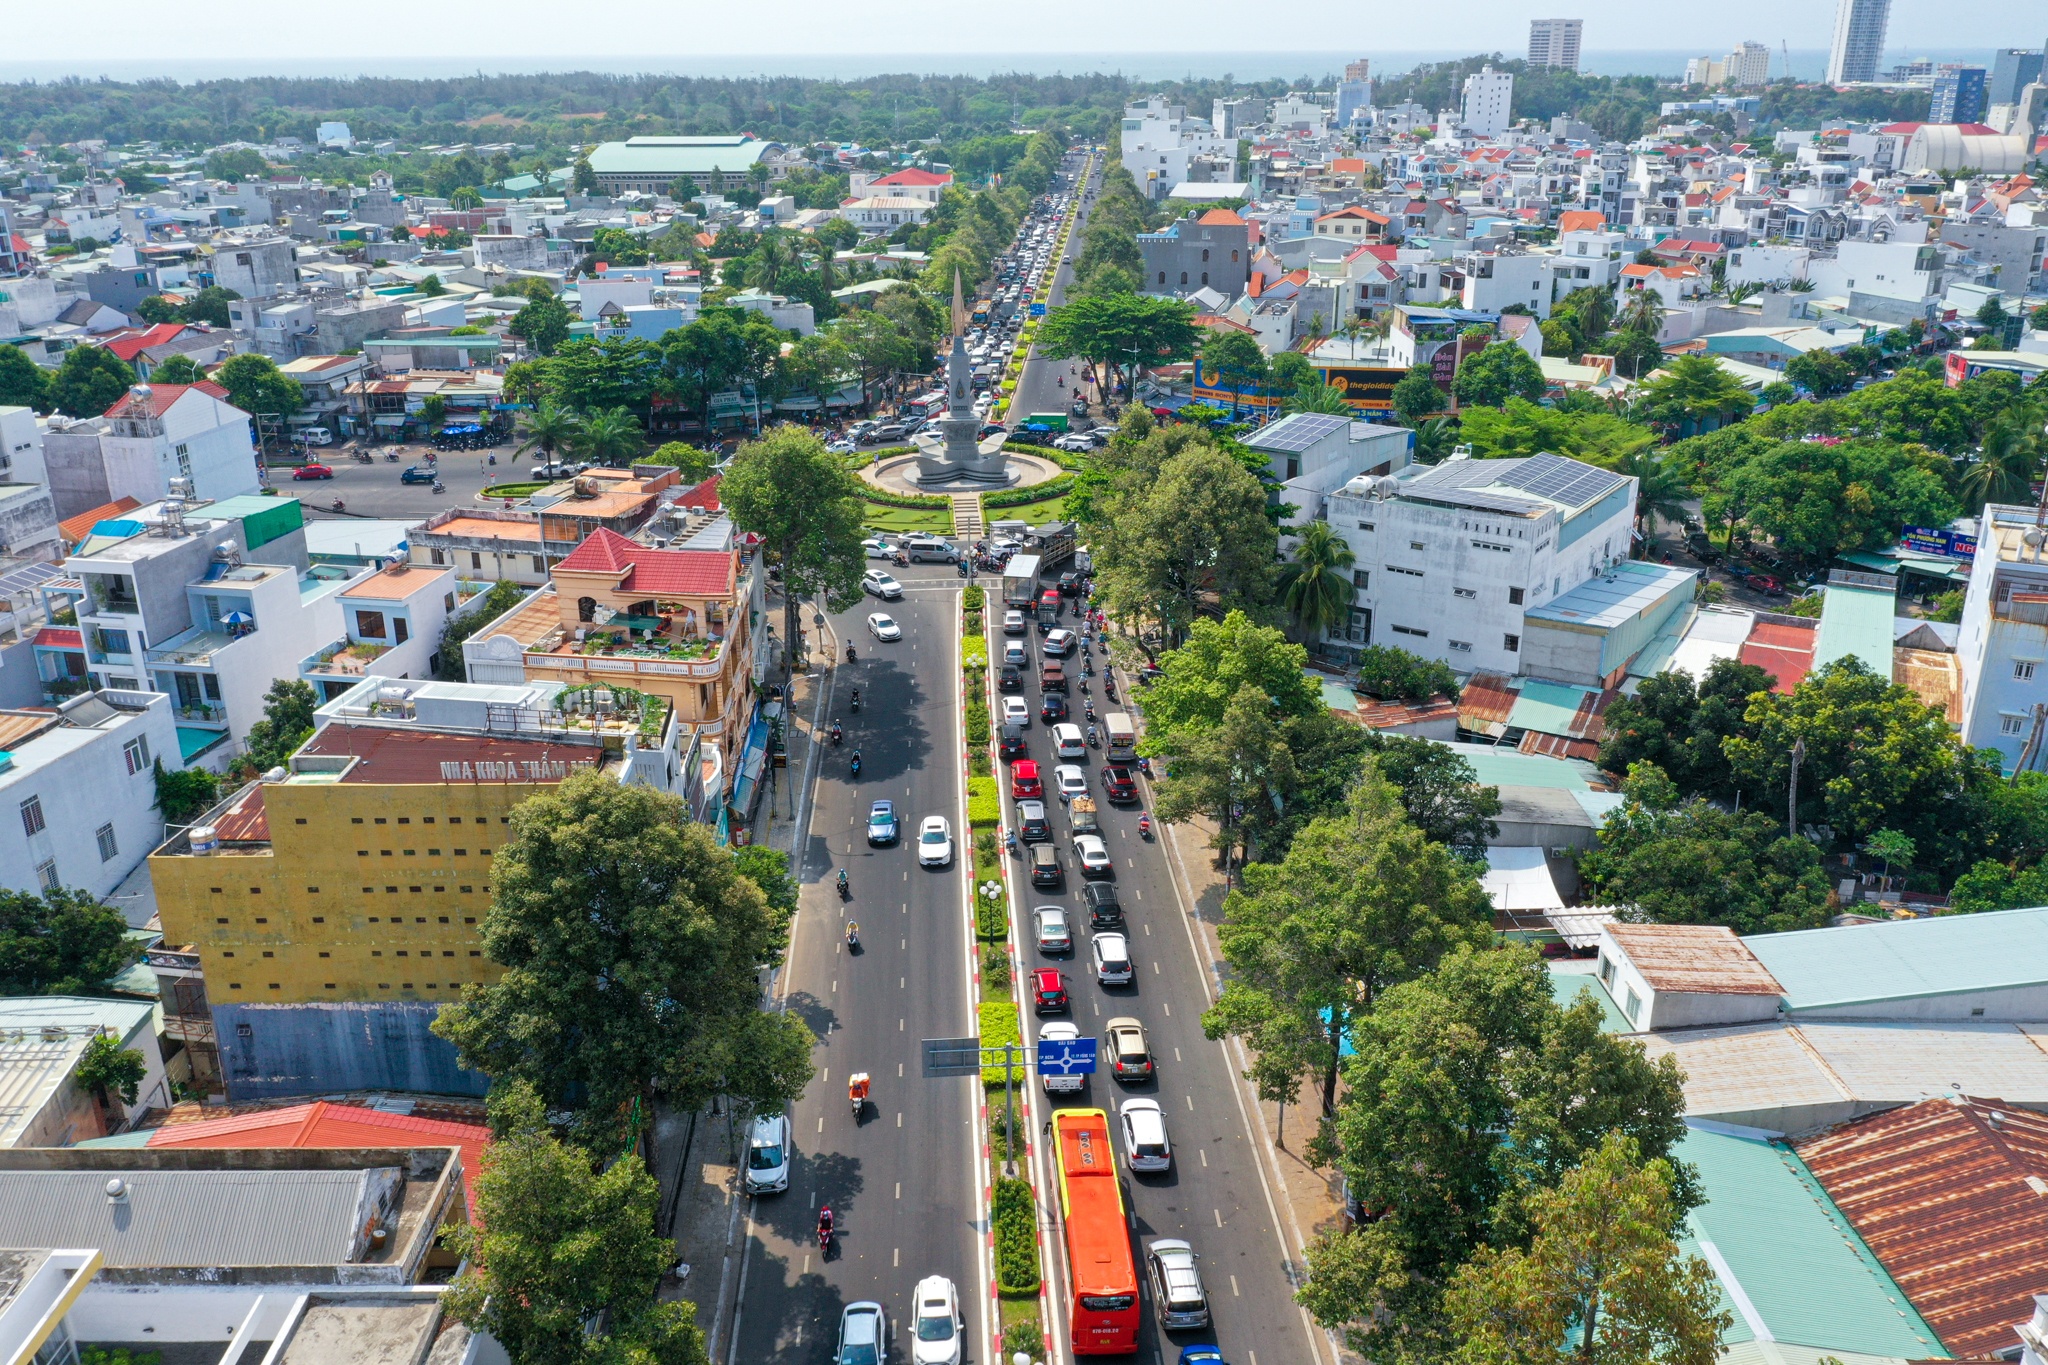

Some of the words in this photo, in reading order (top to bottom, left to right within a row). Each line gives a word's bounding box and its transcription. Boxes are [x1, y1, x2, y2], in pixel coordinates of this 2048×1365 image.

[1350, 382, 1395, 391] thegioidido
[440, 761, 474, 779] NHA
[475, 761, 518, 779] KHOA
